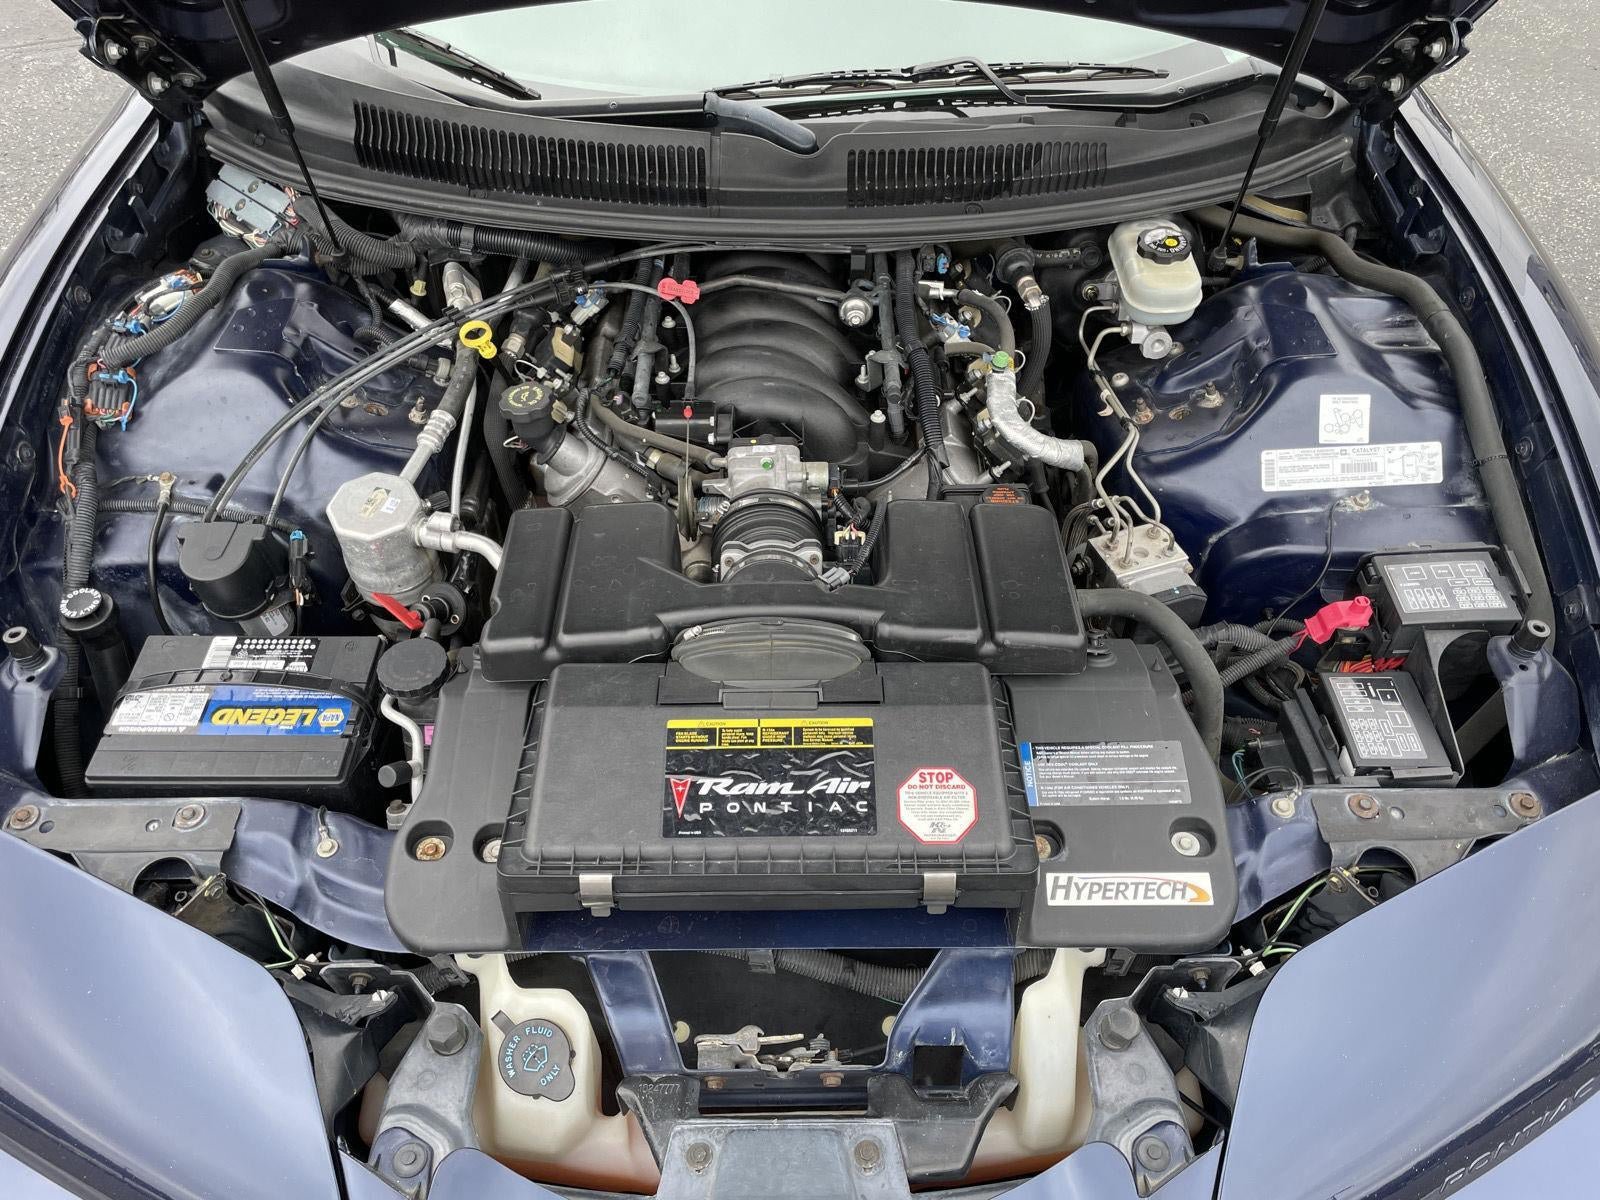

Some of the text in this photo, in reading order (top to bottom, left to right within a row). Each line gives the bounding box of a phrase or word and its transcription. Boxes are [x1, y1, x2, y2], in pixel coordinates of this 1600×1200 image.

[211, 707, 318, 726] LEGEND
[322, 714, 341, 722] NAPA
[919, 771, 954, 784] STOP
[1023, 760, 1034, 788] NOTICE
[696, 777, 871, 798] Ram Air
[699, 801, 869, 814] PONTIAC
[1050, 875, 1189, 901] HYPERTECH
[504, 1026, 561, 1087] WASHER FLUID ONLY
[1439, 1076, 1596, 1194] PONTIAC
